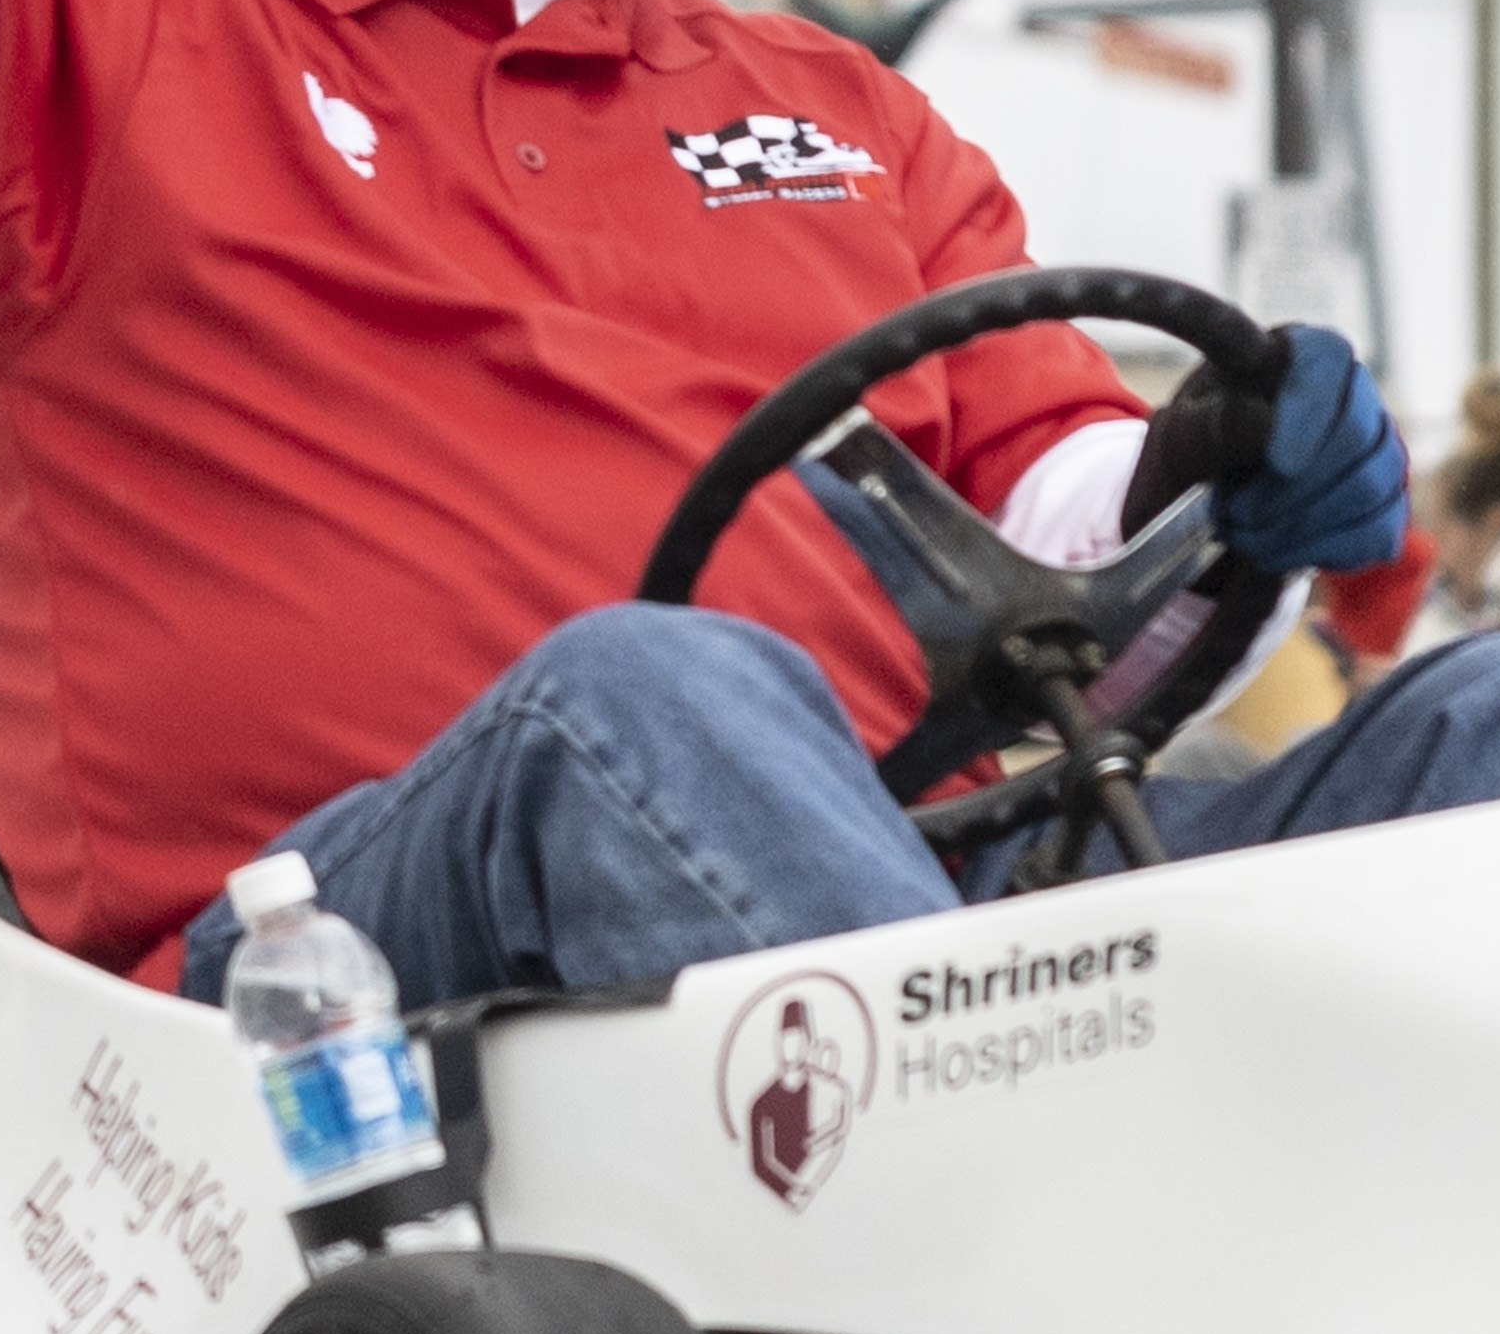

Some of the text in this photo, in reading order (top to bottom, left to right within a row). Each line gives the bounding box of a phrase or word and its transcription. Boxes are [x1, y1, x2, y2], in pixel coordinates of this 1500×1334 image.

[898, 928, 1160, 1025] Shriners
[896, 989, 1158, 1104] Hospitals
[70, 1036, 248, 1304] Helping Kids
